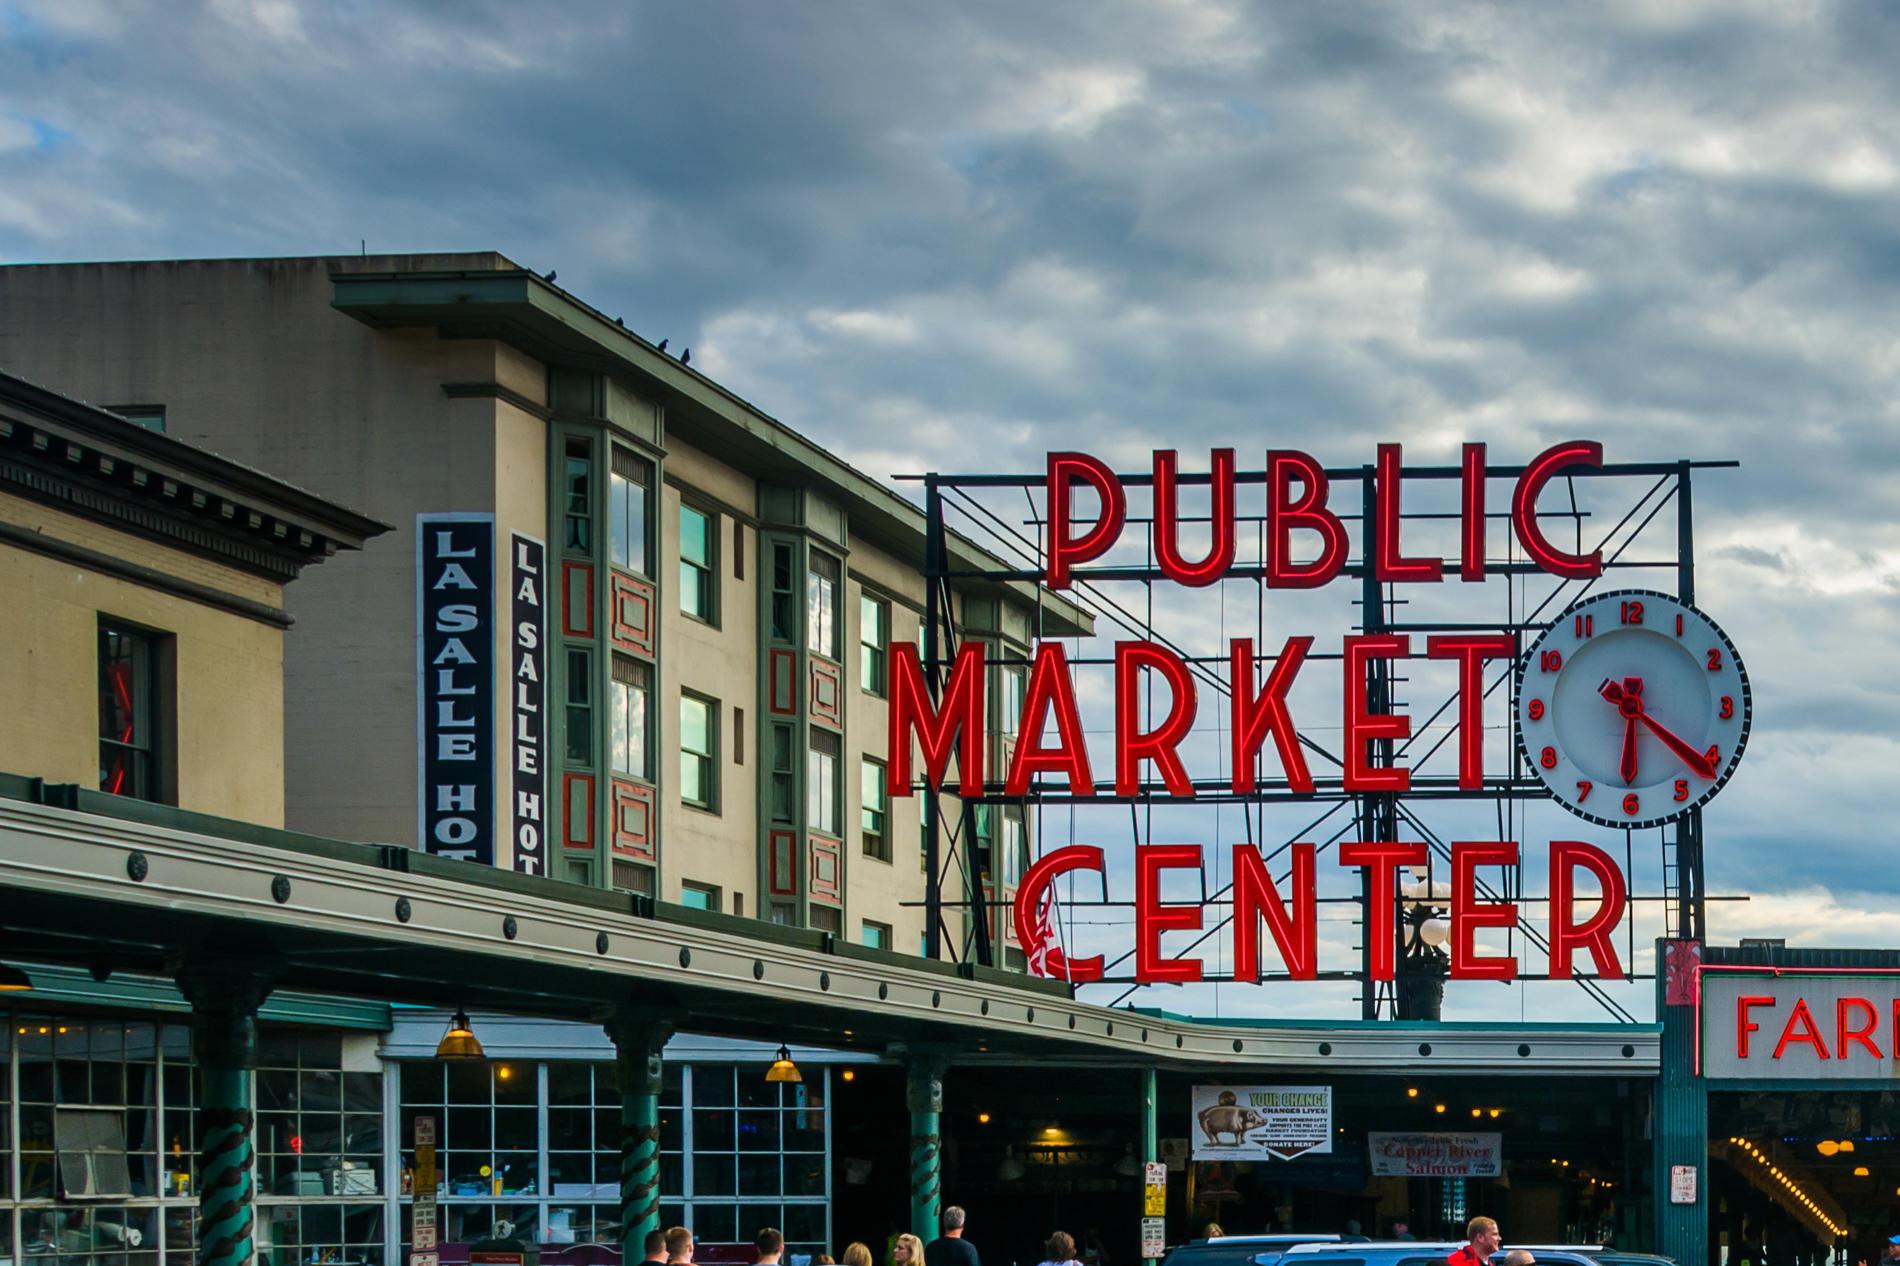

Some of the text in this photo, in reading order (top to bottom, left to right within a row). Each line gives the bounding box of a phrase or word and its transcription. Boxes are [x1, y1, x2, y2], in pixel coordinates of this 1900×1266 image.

[1045, 440, 1603, 590] PUBLIC
[433, 531, 478, 590] LA
[517, 542, 538, 606] LA
[1621, 601, 1643, 624] 12
[1575, 614, 1592, 638] 11
[1676, 614, 1683, 637] 1
[1541, 650, 1561, 672] 10
[1707, 648, 1721, 670] 2
[432, 604, 479, 761] SALLE
[517, 622, 538, 774] SALLE
[1719, 696, 1733, 718] 3
[887, 634, 1515, 798] MARKET
[1528, 699, 1544, 720] 9
[1541, 746, 1556, 768] 8
[1576, 781, 1592, 802] 7
[1674, 780, 1688, 800] 5
[1623, 793, 1639, 814] 6
[1014, 840, 1627, 983] CENTER
[1249, 1093, 1328, 1107] YOUR CHANGE
[1383, 1142, 1490, 1161] Copper River
[1406, 1161, 1468, 1175] Salmon
